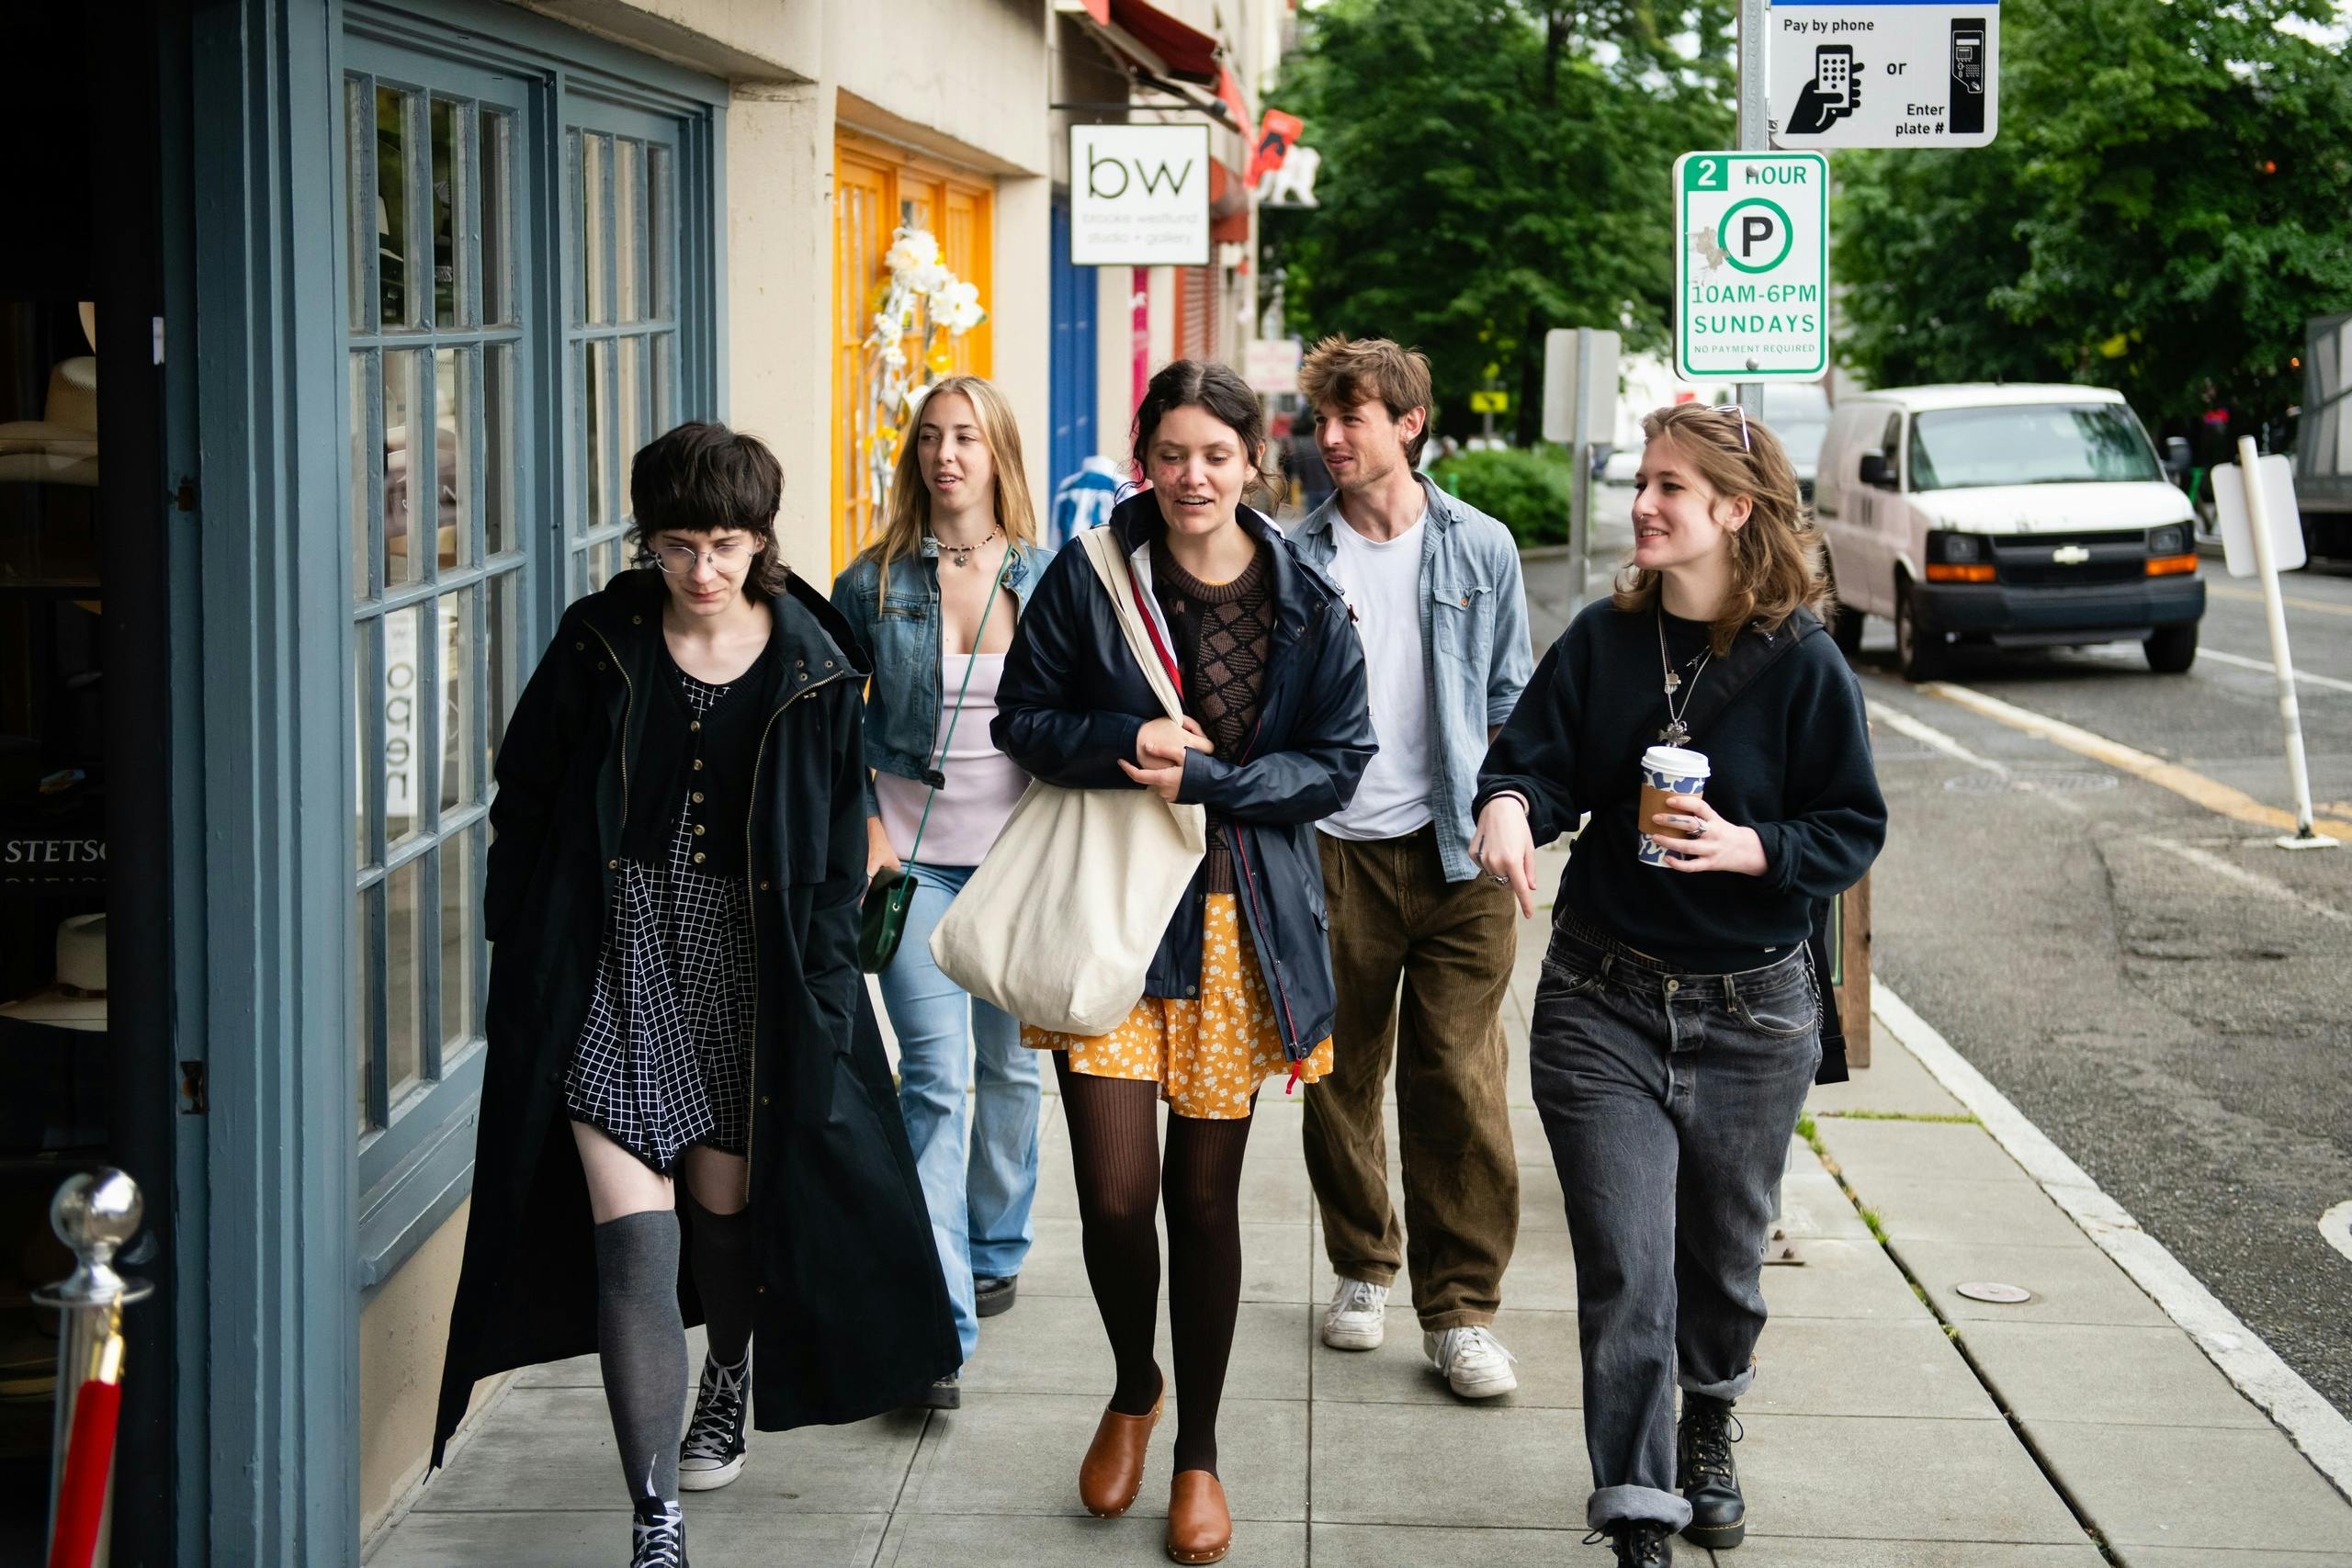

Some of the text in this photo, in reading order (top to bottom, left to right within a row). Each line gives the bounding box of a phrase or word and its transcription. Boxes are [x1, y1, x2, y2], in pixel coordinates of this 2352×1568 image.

[1783, 18, 1874, 34] Pay by phone
[1886, 62, 1907, 75] or
[1906, 103, 1945, 116] Enter
[1895, 121, 1945, 137] plate #
[1088, 141, 1193, 199] bw
[1697, 159, 1717, 186] 2
[1742, 216, 1774, 257] P
[1691, 284, 1816, 303] 10AM-6PM
[1694, 314, 1815, 333] SUNDAYS
[1694, 344, 1815, 354] NO PAYMENT REQUIRED
